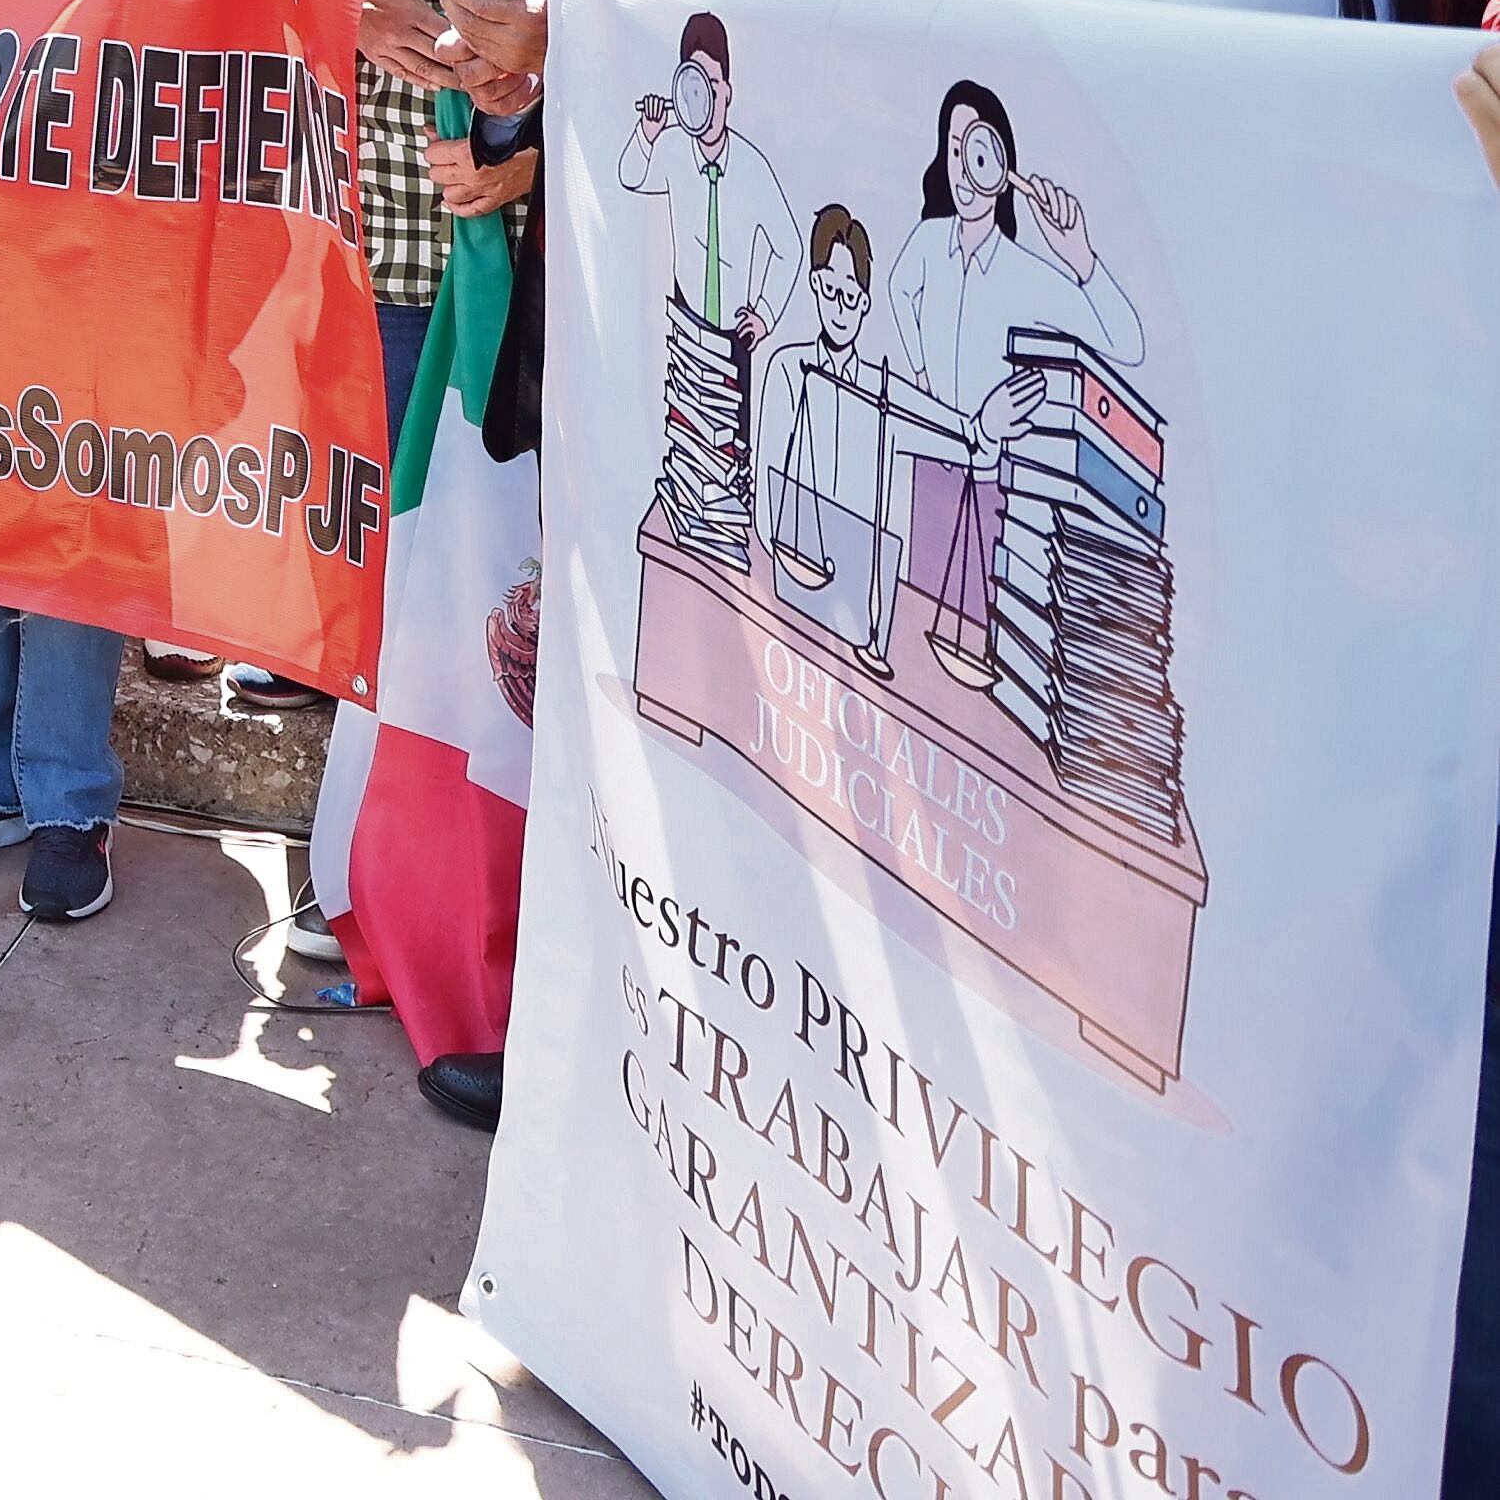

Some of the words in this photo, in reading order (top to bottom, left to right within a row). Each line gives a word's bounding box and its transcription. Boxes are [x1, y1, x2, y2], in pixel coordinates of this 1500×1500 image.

[750, 691, 1018, 932] JUDICIALES
[763, 637, 1008, 846] OFICIALES
[621, 964, 650, 1037] es
[657, 987, 1049, 1399] TRABAJAR
[1068, 1371, 1258, 1500] par
[793, 959, 1370, 1477] PRIVILEGIO
[678, 1226, 952, 1500] DEREC
[690, 1379, 790, 1500] #TOD
